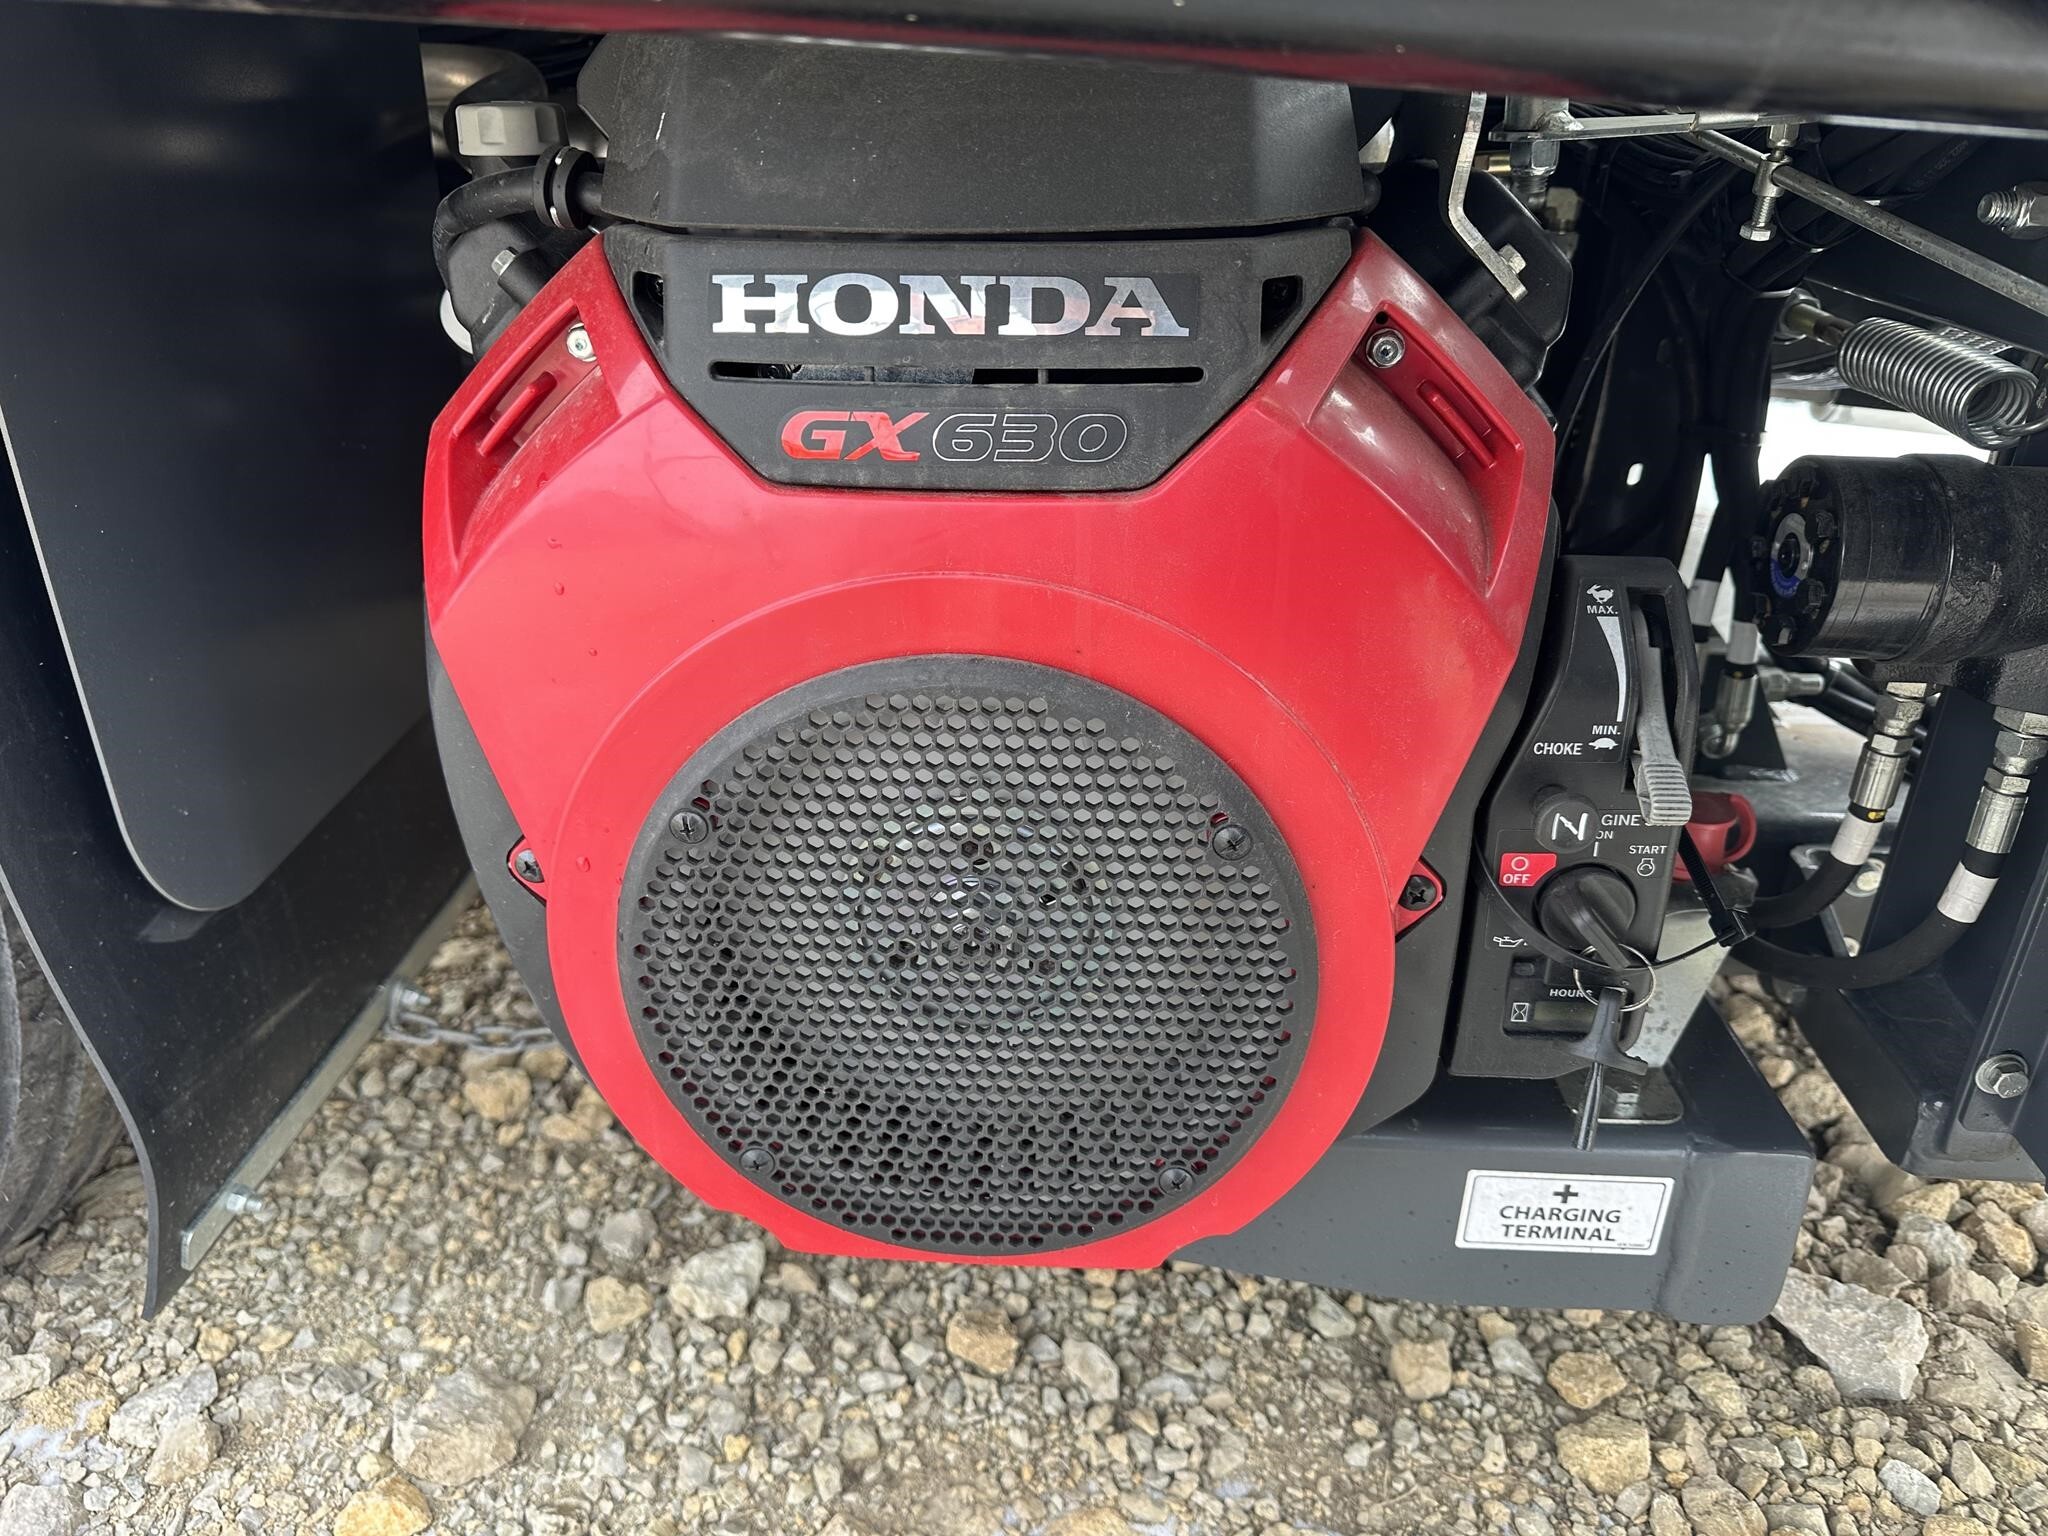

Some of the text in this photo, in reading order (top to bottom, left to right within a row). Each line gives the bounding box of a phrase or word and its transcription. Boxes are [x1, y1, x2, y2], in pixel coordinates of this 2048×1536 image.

[711, 272, 1190, 337] HONDA
[1586, 605, 1619, 615] MAX.
[1591, 725, 1621, 735] MIN.
[1533, 742, 1583, 755] CHOKE
[1601, 814, 1641, 826] GINE
[1629, 845, 1668, 854] START
[1502, 873, 1531, 884] OFF
[1499, 1205, 1622, 1224] CHARGING
[1502, 1223, 1617, 1243] TERMINAL
